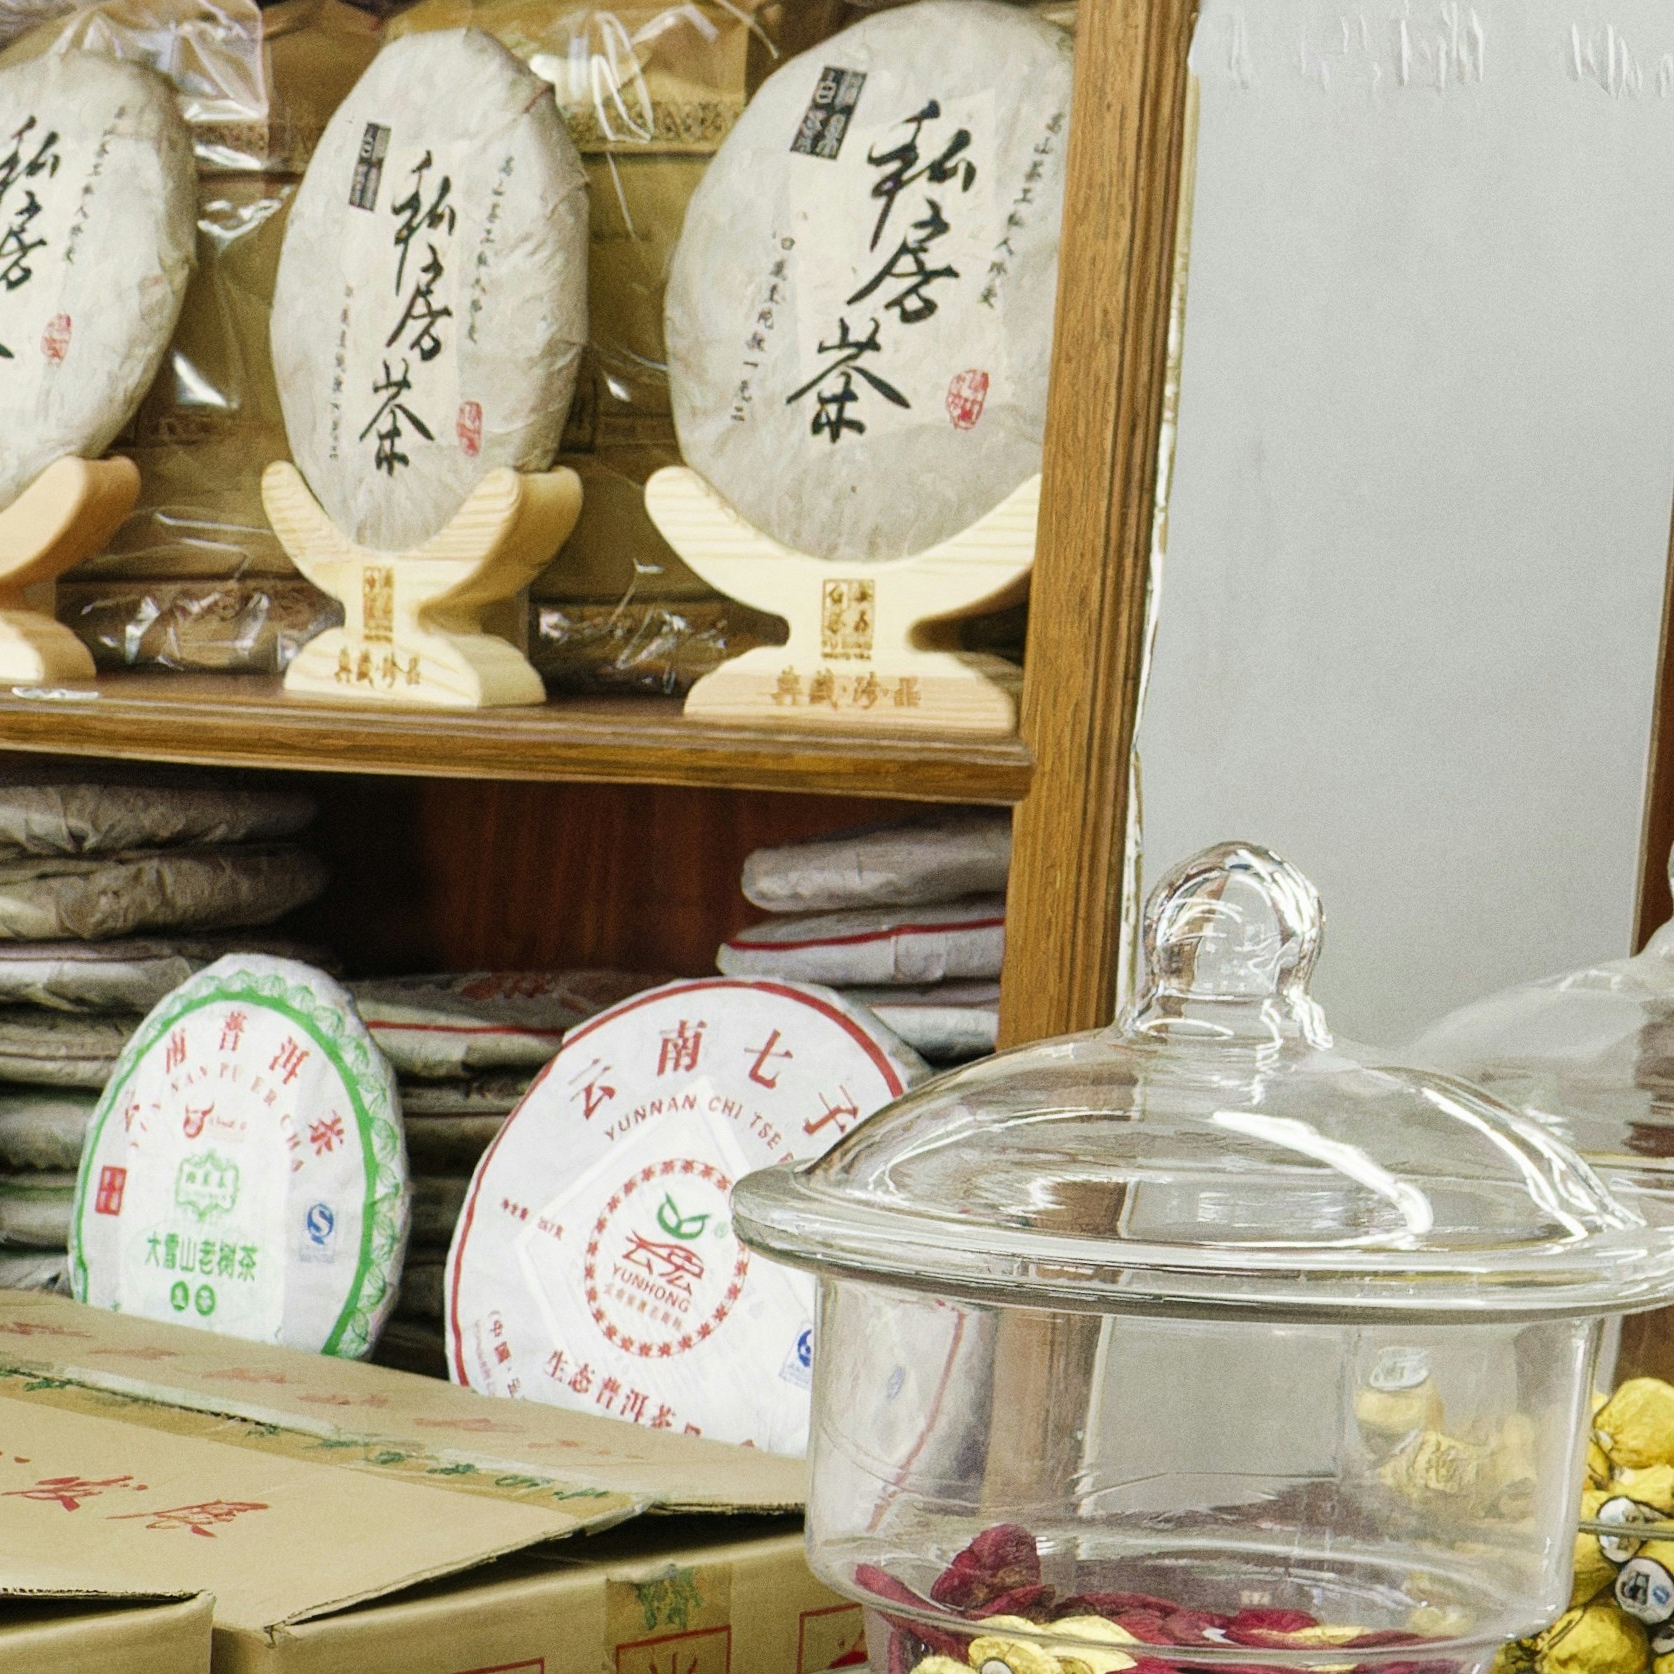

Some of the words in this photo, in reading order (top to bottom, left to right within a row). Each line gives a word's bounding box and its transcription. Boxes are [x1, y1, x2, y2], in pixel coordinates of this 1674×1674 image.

[358, 149, 457, 477] 私房茶
[787, 99, 975, 443] 私房茶
[603, 1094, 699, 1143] YUNNAN
[707, 1095, 745, 1119] CHI
[747, 1114, 782, 1151] TSE
[612, 1259, 692, 1315] YUNHONG
